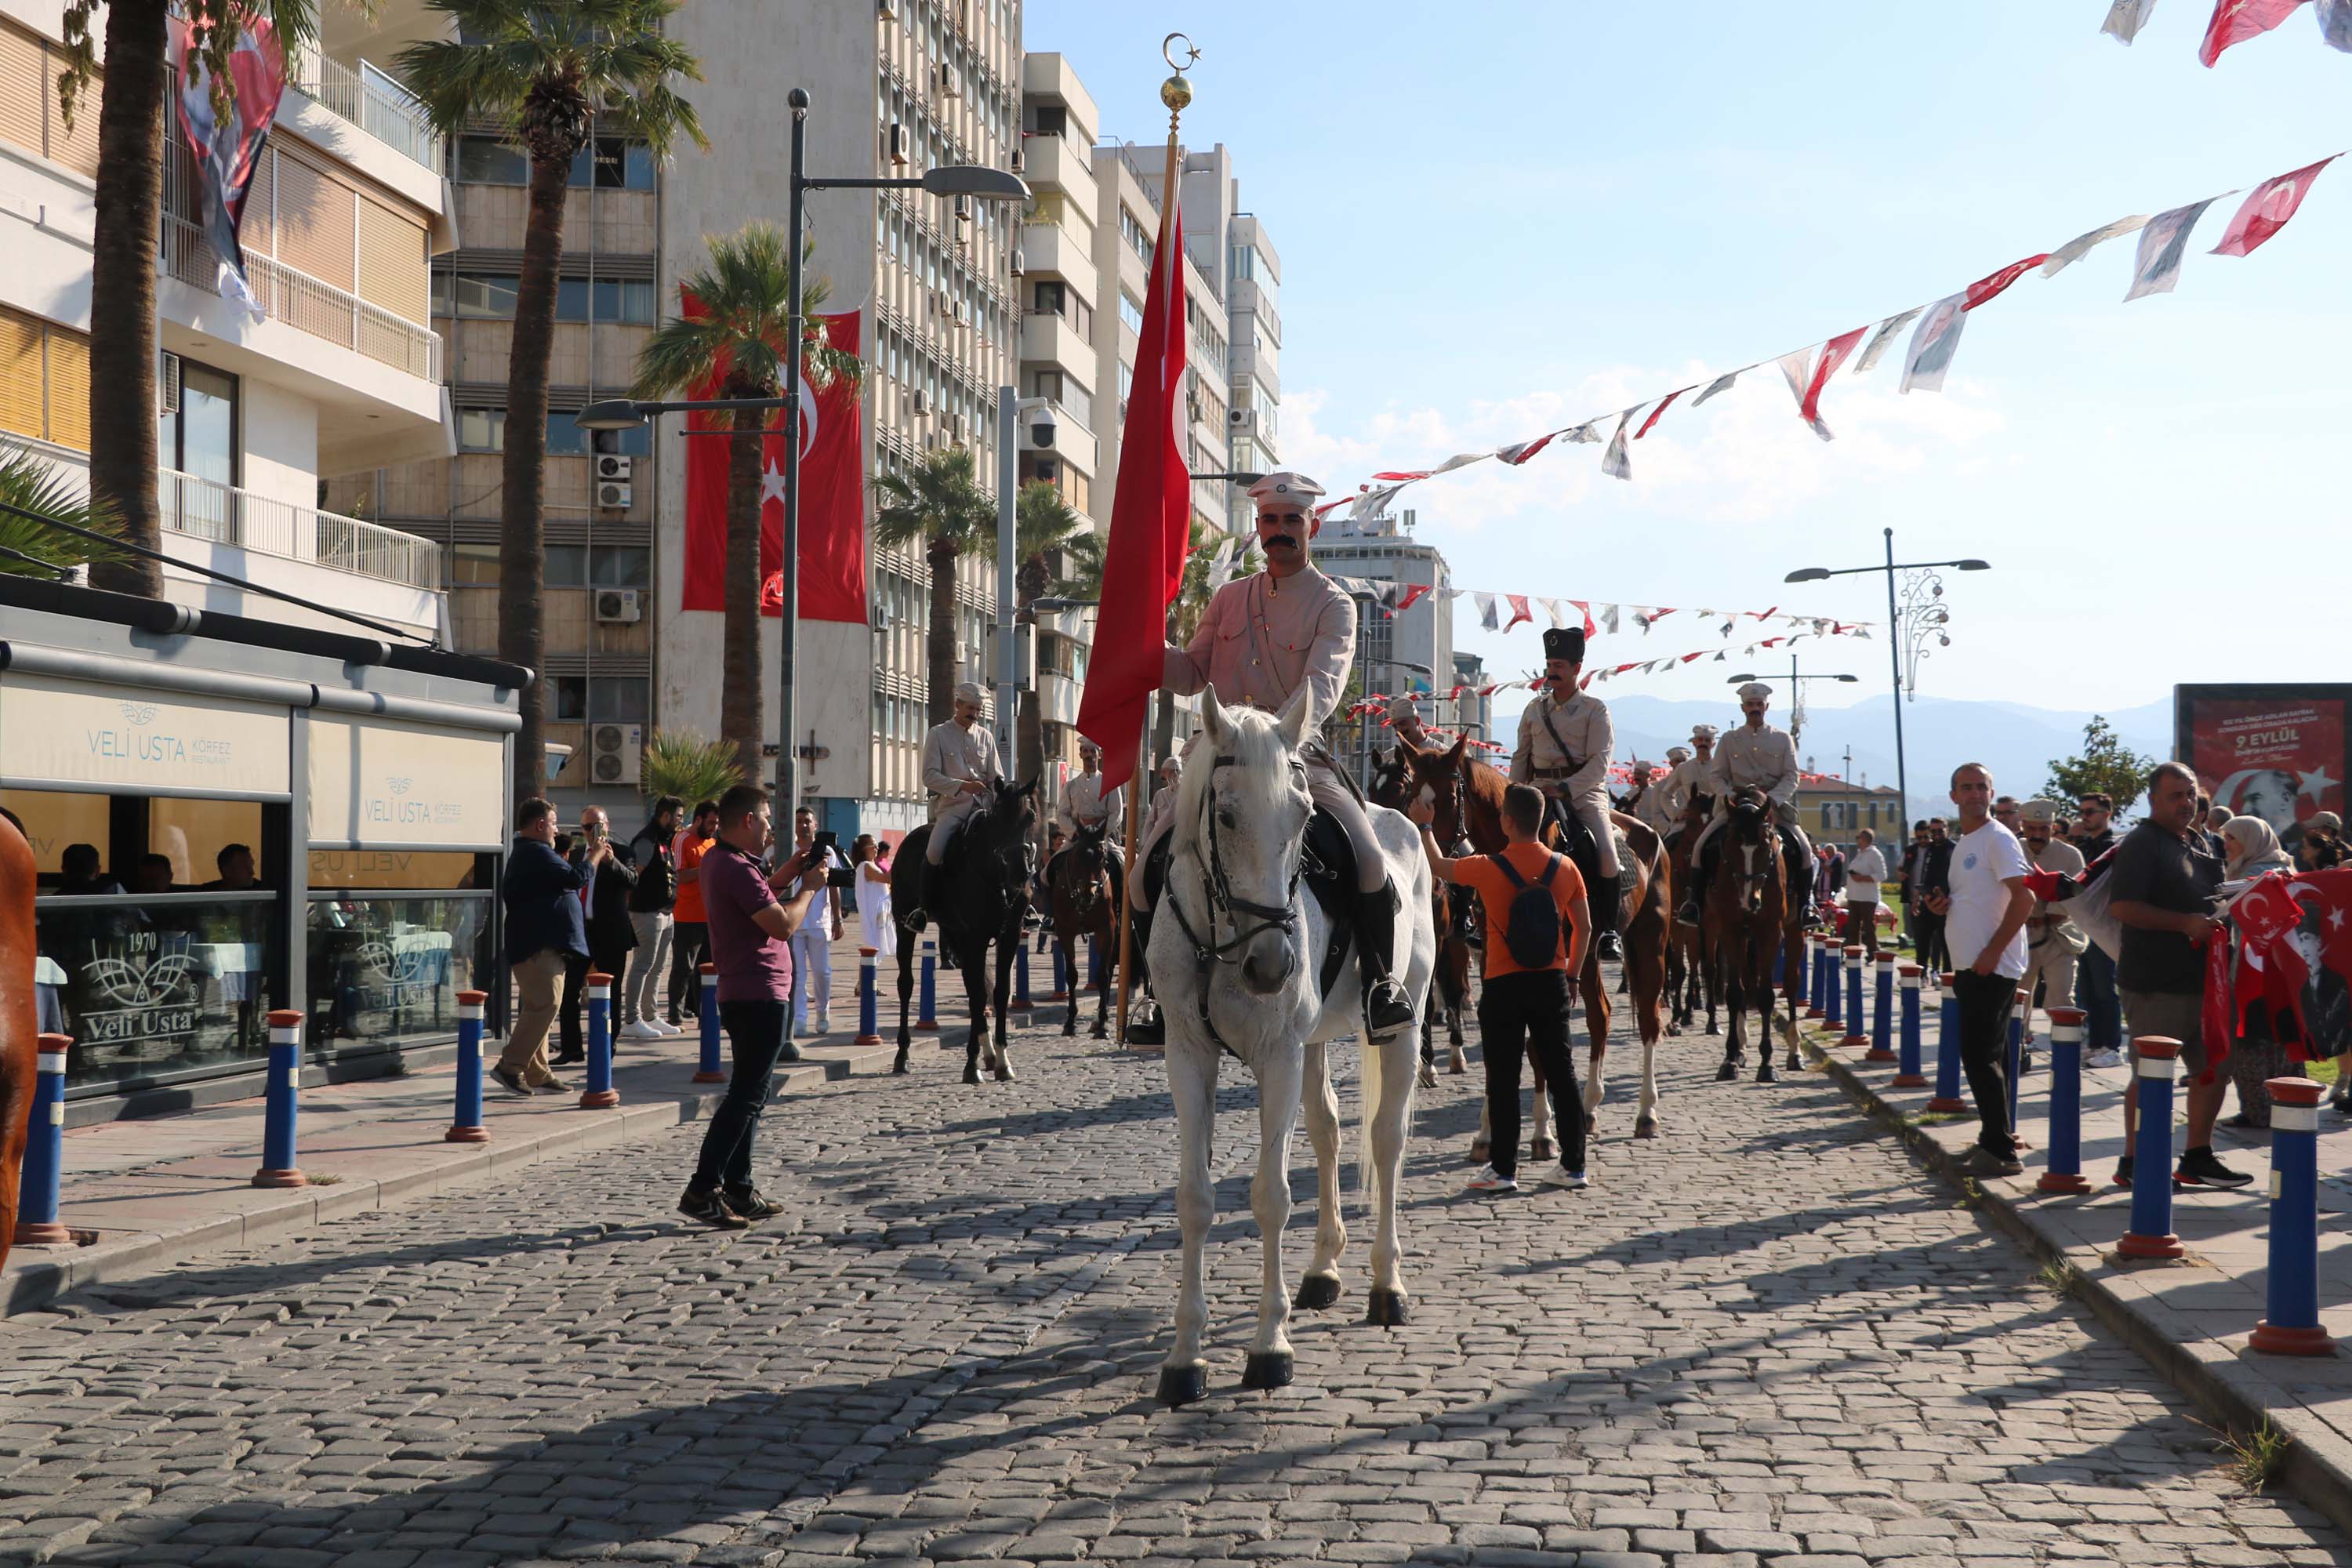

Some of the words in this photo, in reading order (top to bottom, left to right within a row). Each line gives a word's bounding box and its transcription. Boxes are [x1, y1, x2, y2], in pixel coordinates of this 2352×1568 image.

[87, 728, 131, 758] VELİ
[139, 735, 186, 762] USTA
[192, 737, 232, 755] KÖRFEZ
[2235, 735, 2246, 748] 9
[2250, 726, 2299, 745] EYLÜL
[365, 797, 394, 822] VELİ
[398, 802, 431, 823] USTA
[129, 931, 157, 953] 1970
[86, 1013, 132, 1040] Veli
[142, 1010, 193, 1034] Usta
